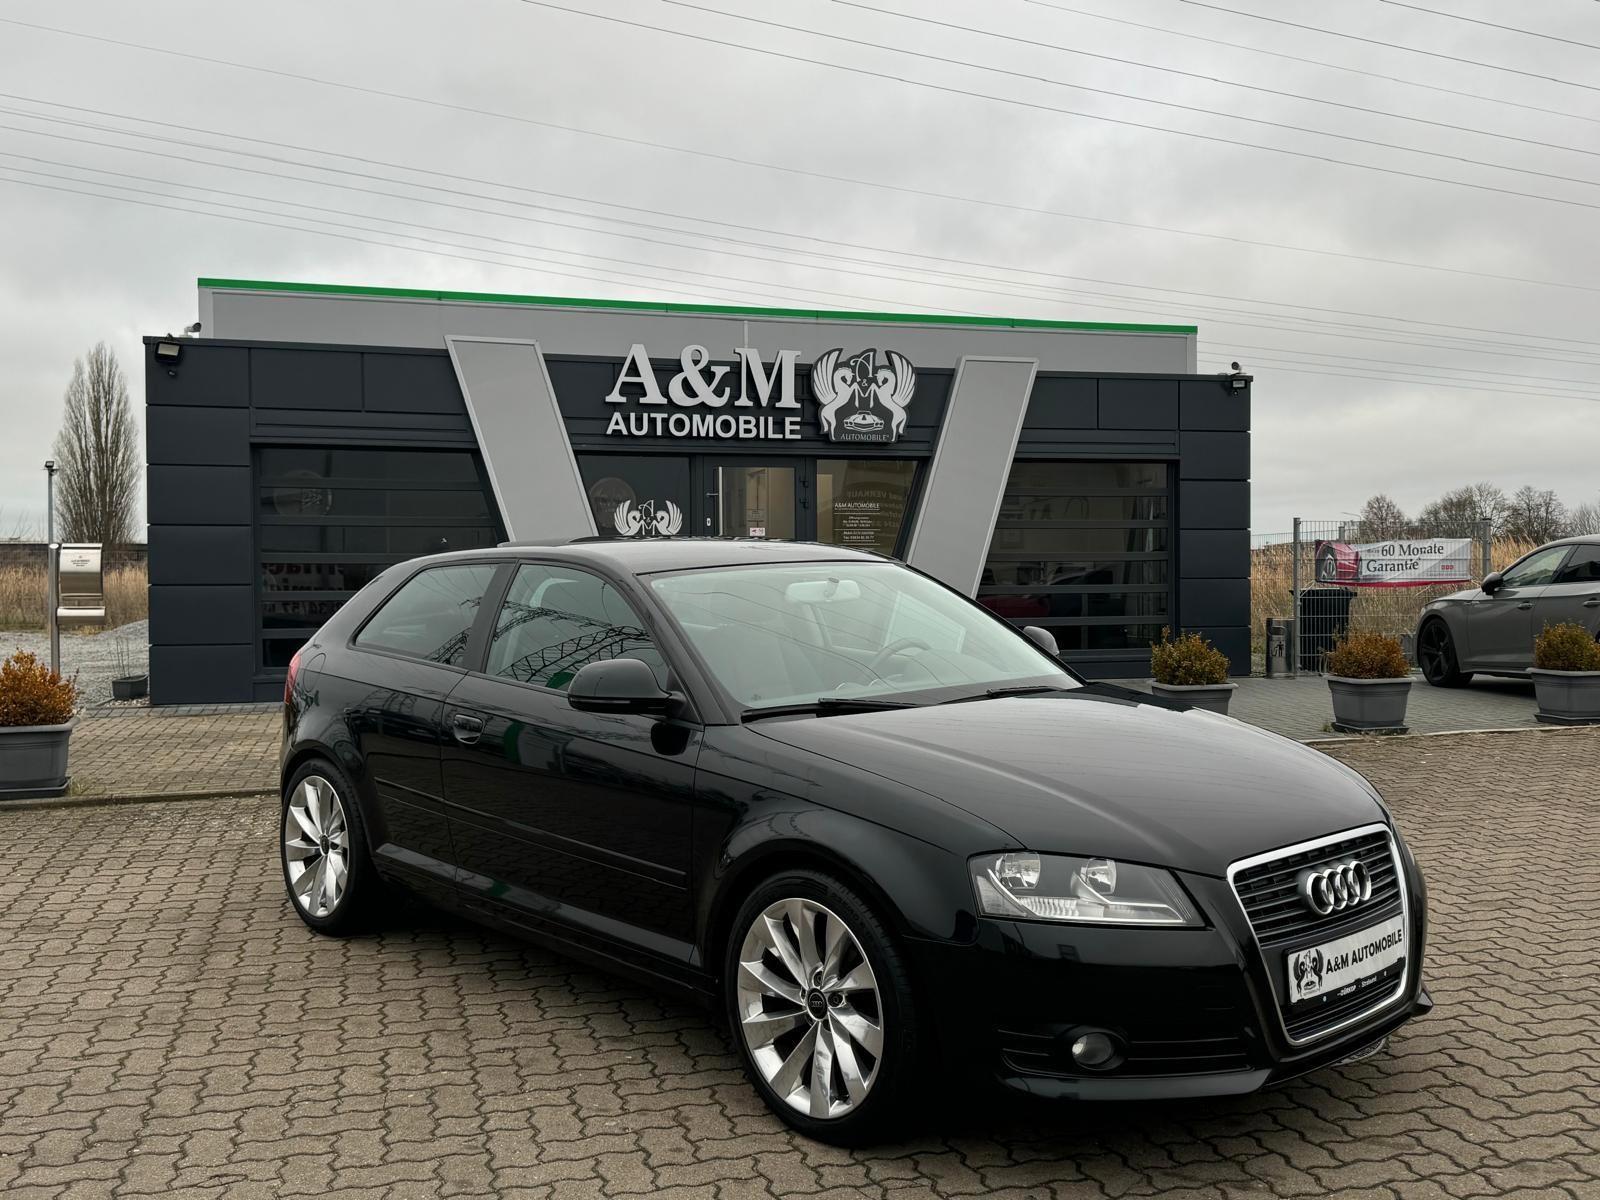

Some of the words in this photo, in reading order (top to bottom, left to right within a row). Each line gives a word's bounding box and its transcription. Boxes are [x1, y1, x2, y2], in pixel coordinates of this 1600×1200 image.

[605, 343, 801, 409] A&M
[605, 411, 801, 440] AUTOMOBILE
[1381, 544, 1395, 556] 60
[1398, 543, 1444, 556] Monate
[1326, 953, 1349, 975] A&M
[1351, 929, 1403, 965] AUTOMOBILE
